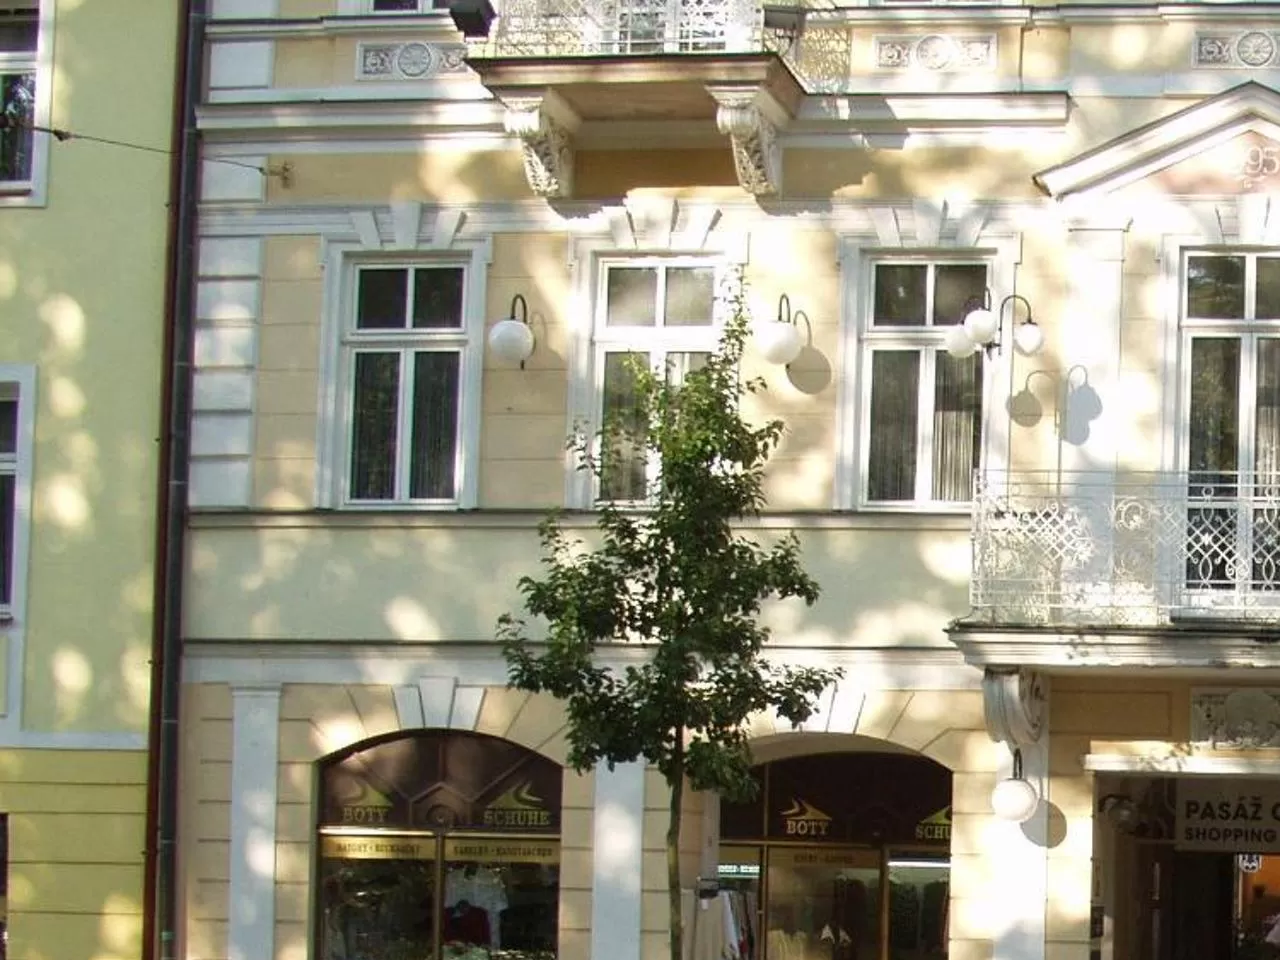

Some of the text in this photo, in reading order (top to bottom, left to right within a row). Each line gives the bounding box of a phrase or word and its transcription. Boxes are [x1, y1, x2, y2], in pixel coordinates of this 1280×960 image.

[342, 806, 388, 824] BOTY
[484, 809, 552, 826] SCHUHE
[1184, 796, 1264, 822] PASÁŽ
[786, 820, 829, 836] BOTY
[915, 824, 952, 839] SCHU
[1184, 827, 1276, 844] SHOPPING
